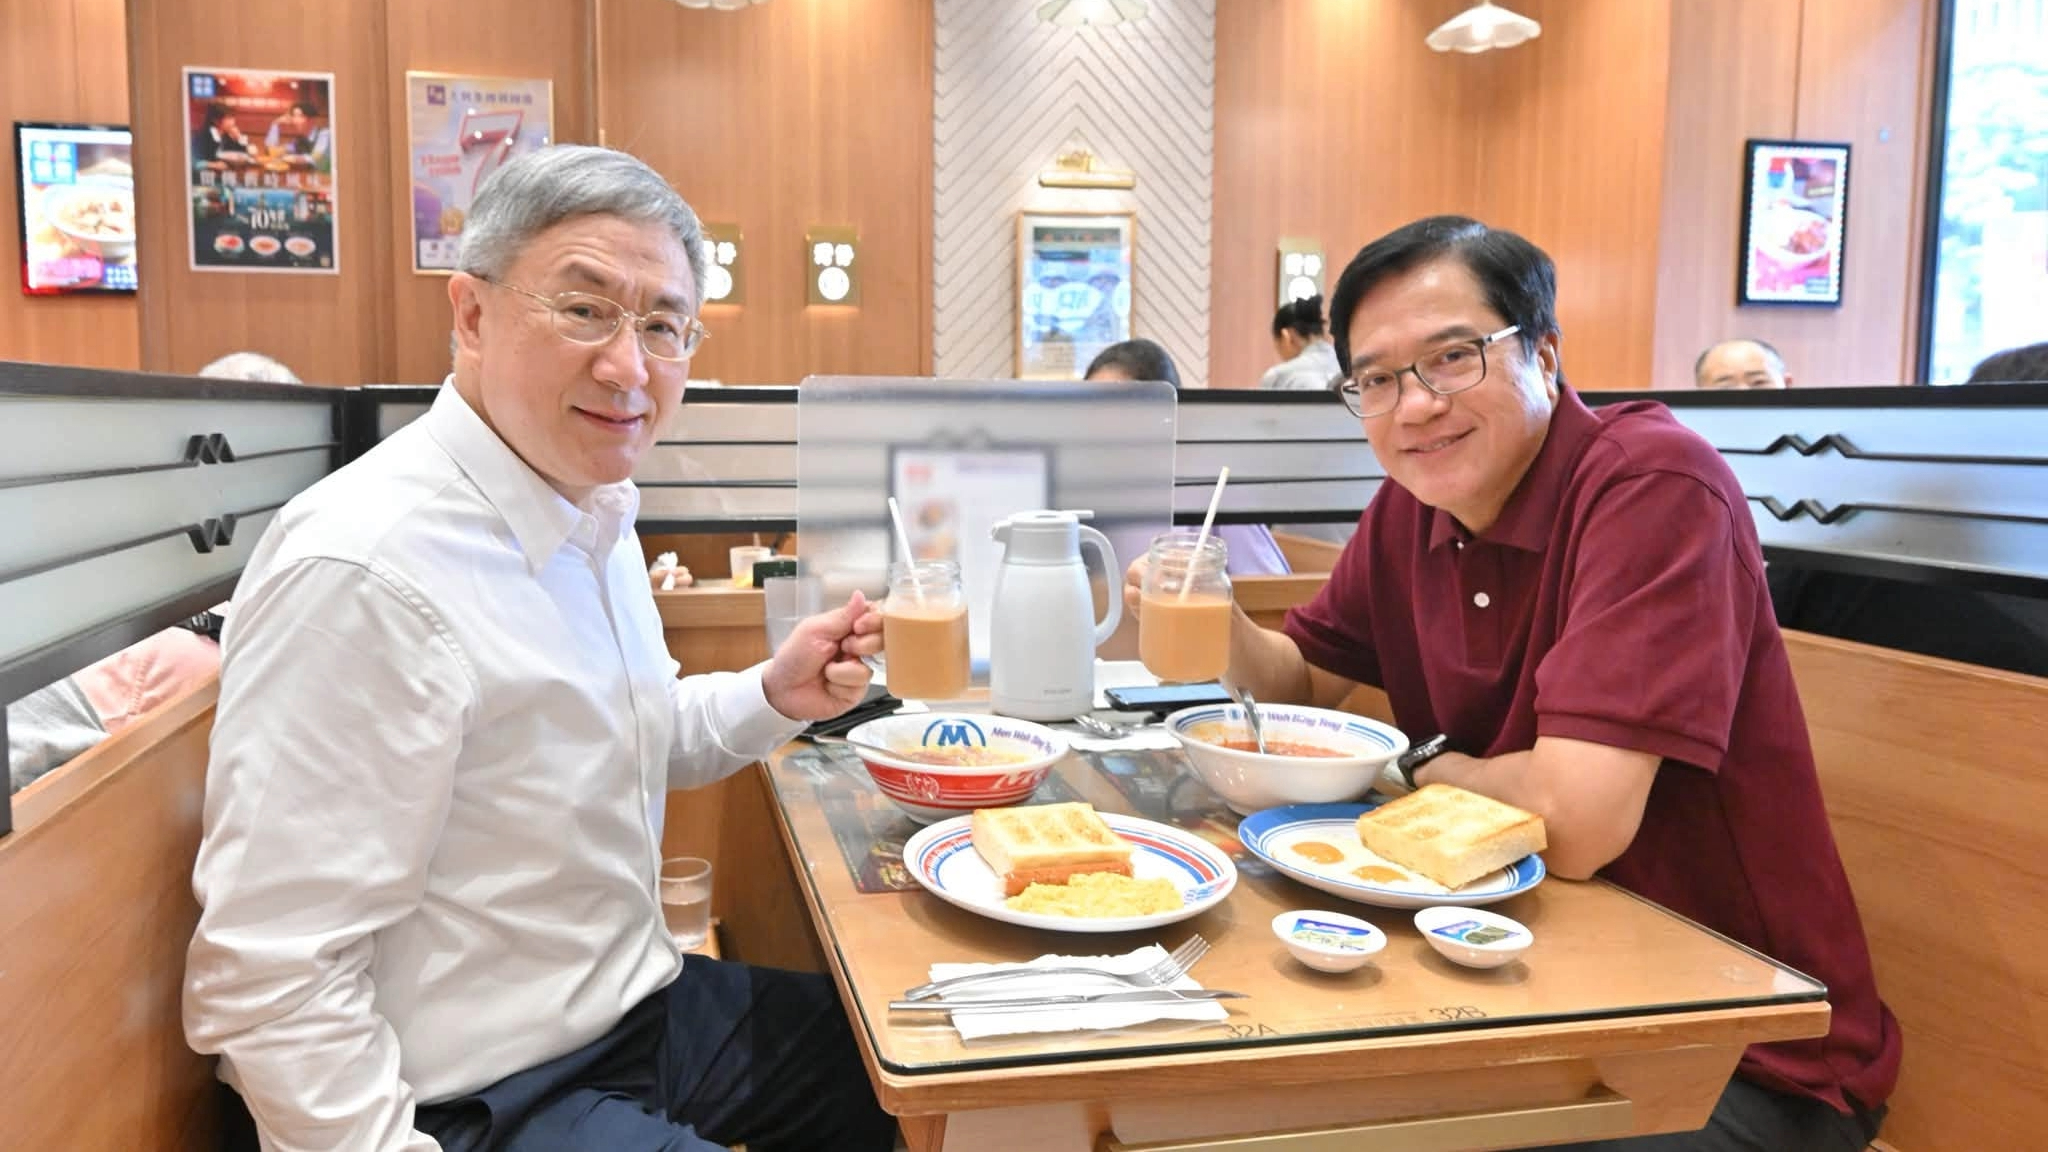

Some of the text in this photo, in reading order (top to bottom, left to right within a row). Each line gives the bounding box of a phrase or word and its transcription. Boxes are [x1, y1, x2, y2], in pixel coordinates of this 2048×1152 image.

[459, 109, 525, 197] 7
[937, 724, 971, 747] M
[1429, 1005, 1488, 1021] 32B
[1223, 1022, 1281, 1038] 32A
